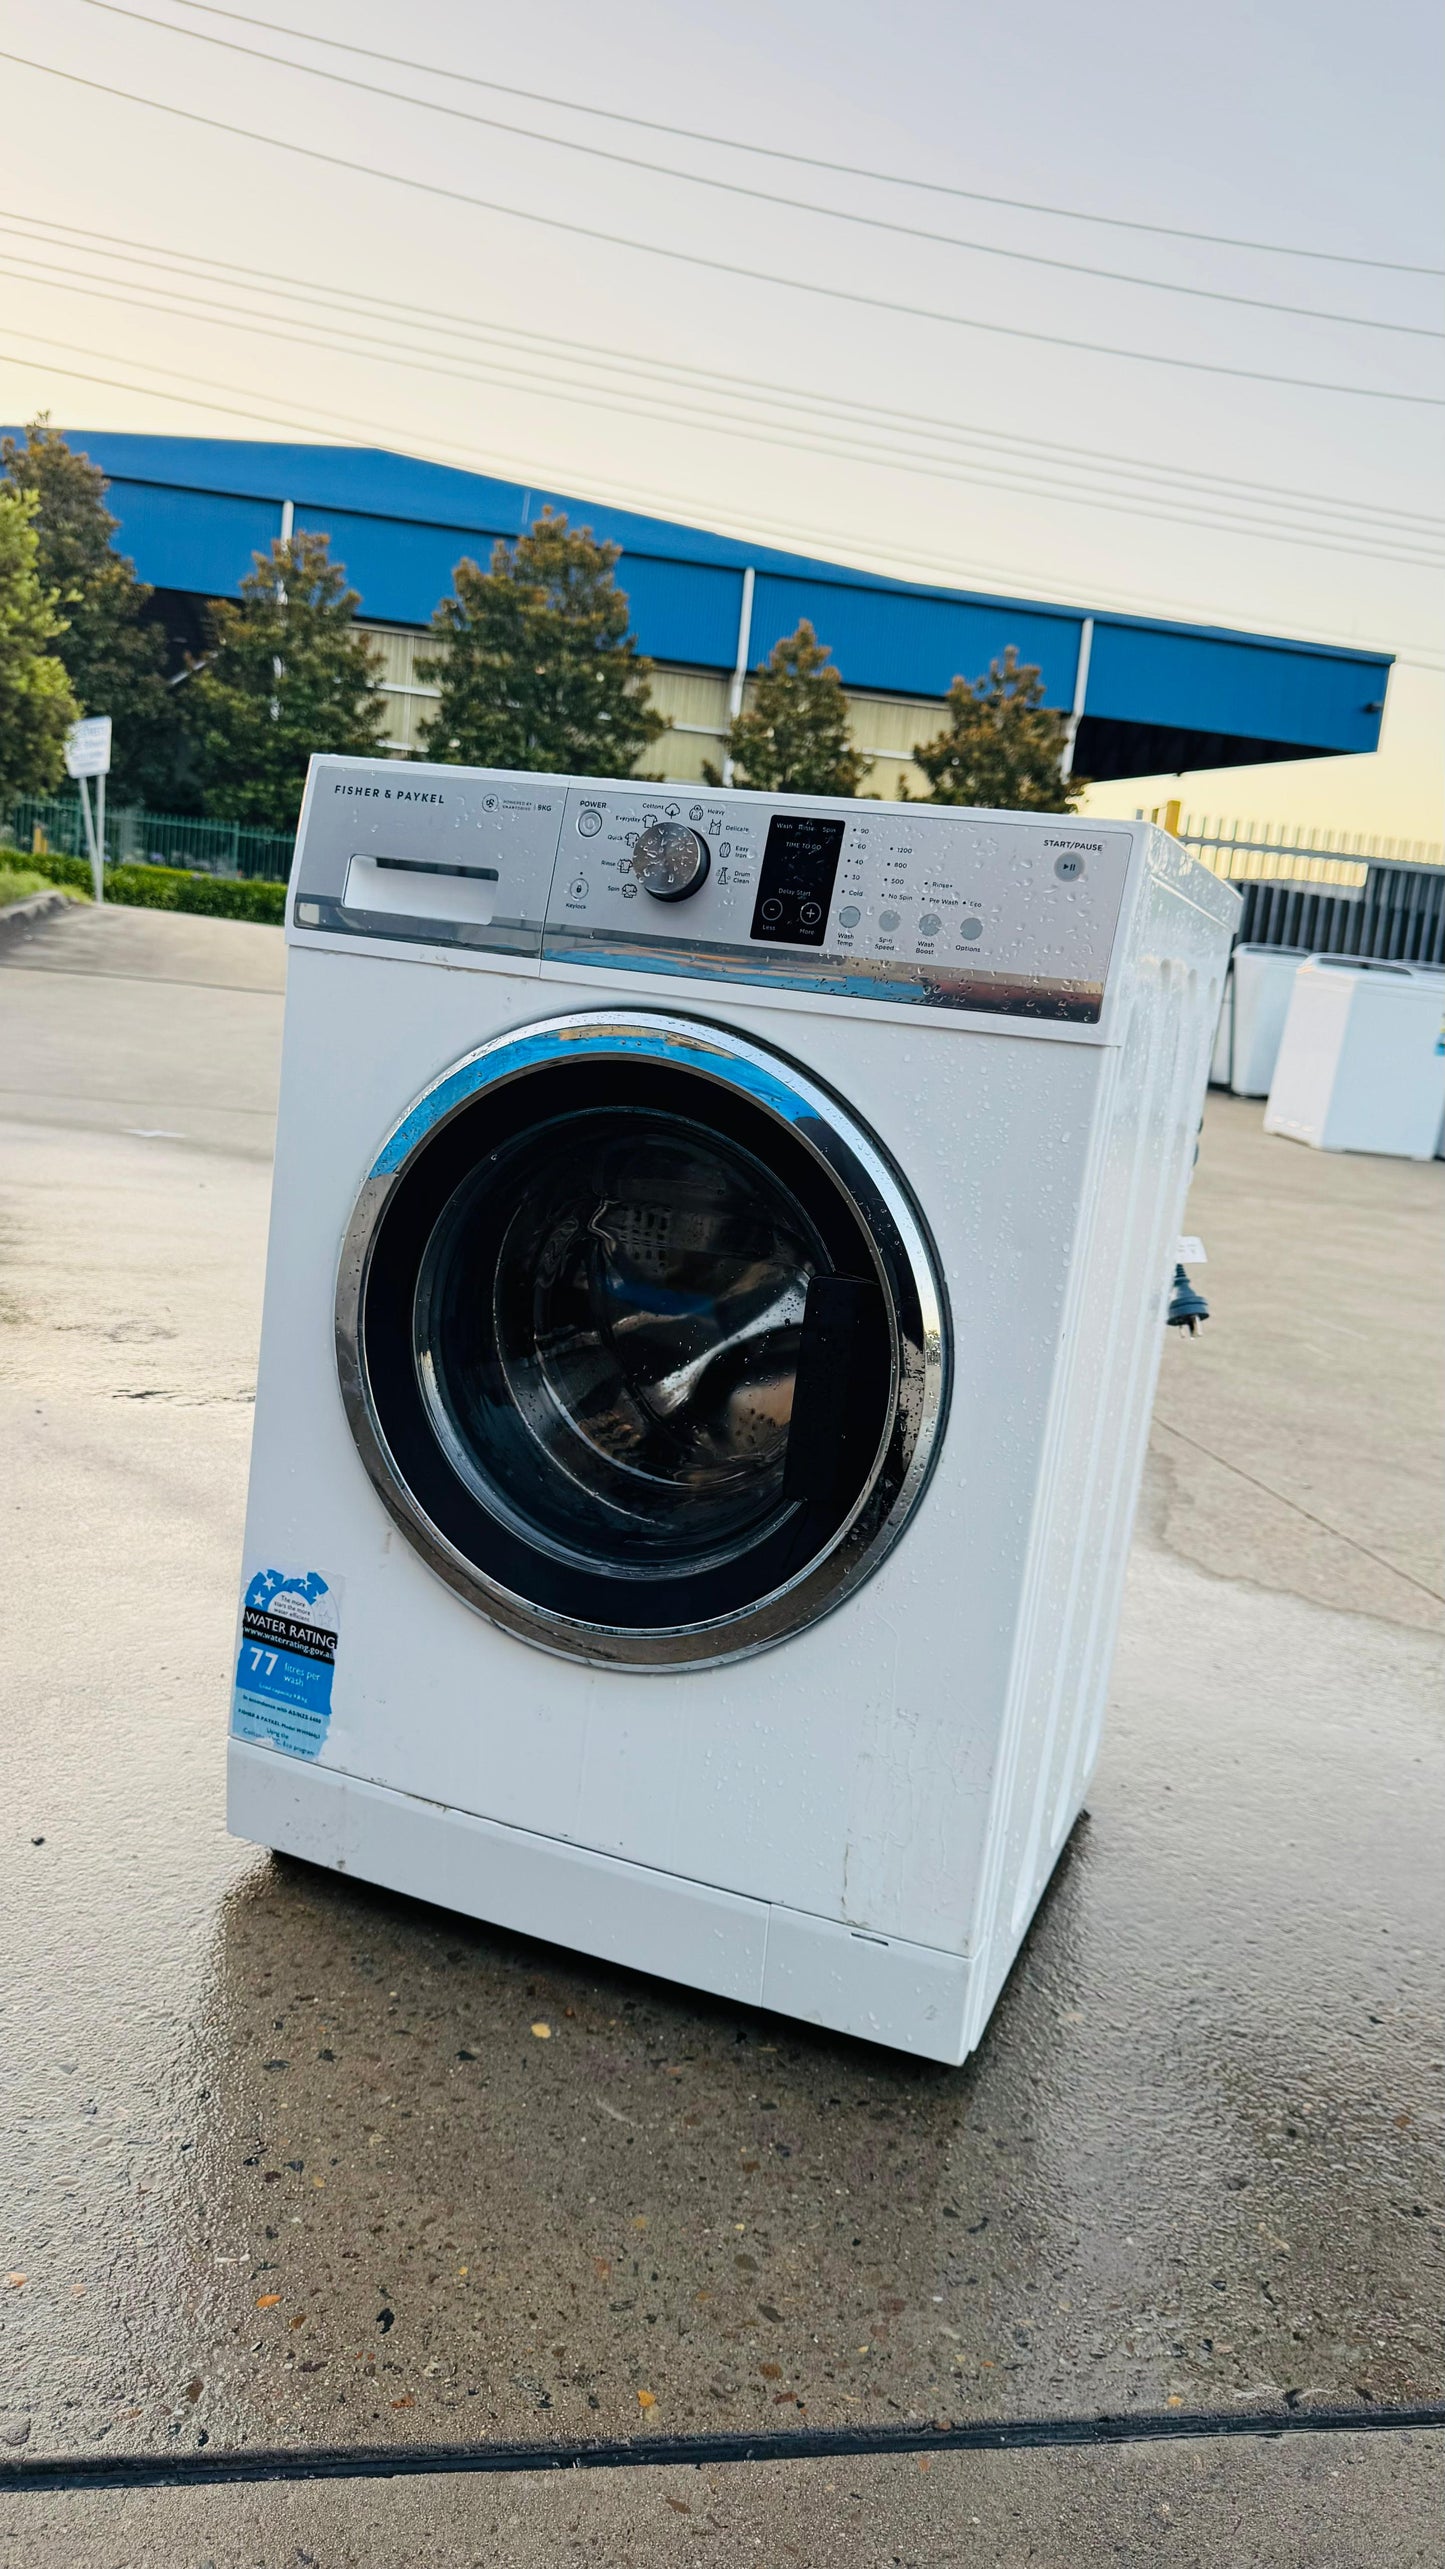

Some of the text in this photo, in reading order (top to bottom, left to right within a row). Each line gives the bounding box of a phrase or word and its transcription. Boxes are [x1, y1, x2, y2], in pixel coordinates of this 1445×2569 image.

[334, 785, 444, 804] FISHER & PAYKEL
[580, 800, 607, 809] POWER
[616, 815, 641, 823] Everyday
[798, 824, 815, 832] Rinse
[735, 845, 749, 853] Easy
[1043, 840, 1103, 851] START/PAUSE
[778, 888, 794, 896] Delay
[955, 945, 981, 953] Options
[281, 1595, 306, 1607] The more
[274, 1601, 311, 1616] stars the more
[274, 1608, 310, 1622] water efficient
[246, 1611, 336, 1649] WATER RATING
[250, 1647, 279, 1676] 77
[284, 1662, 321, 1681] litres per
[284, 1675, 304, 1687] wash
